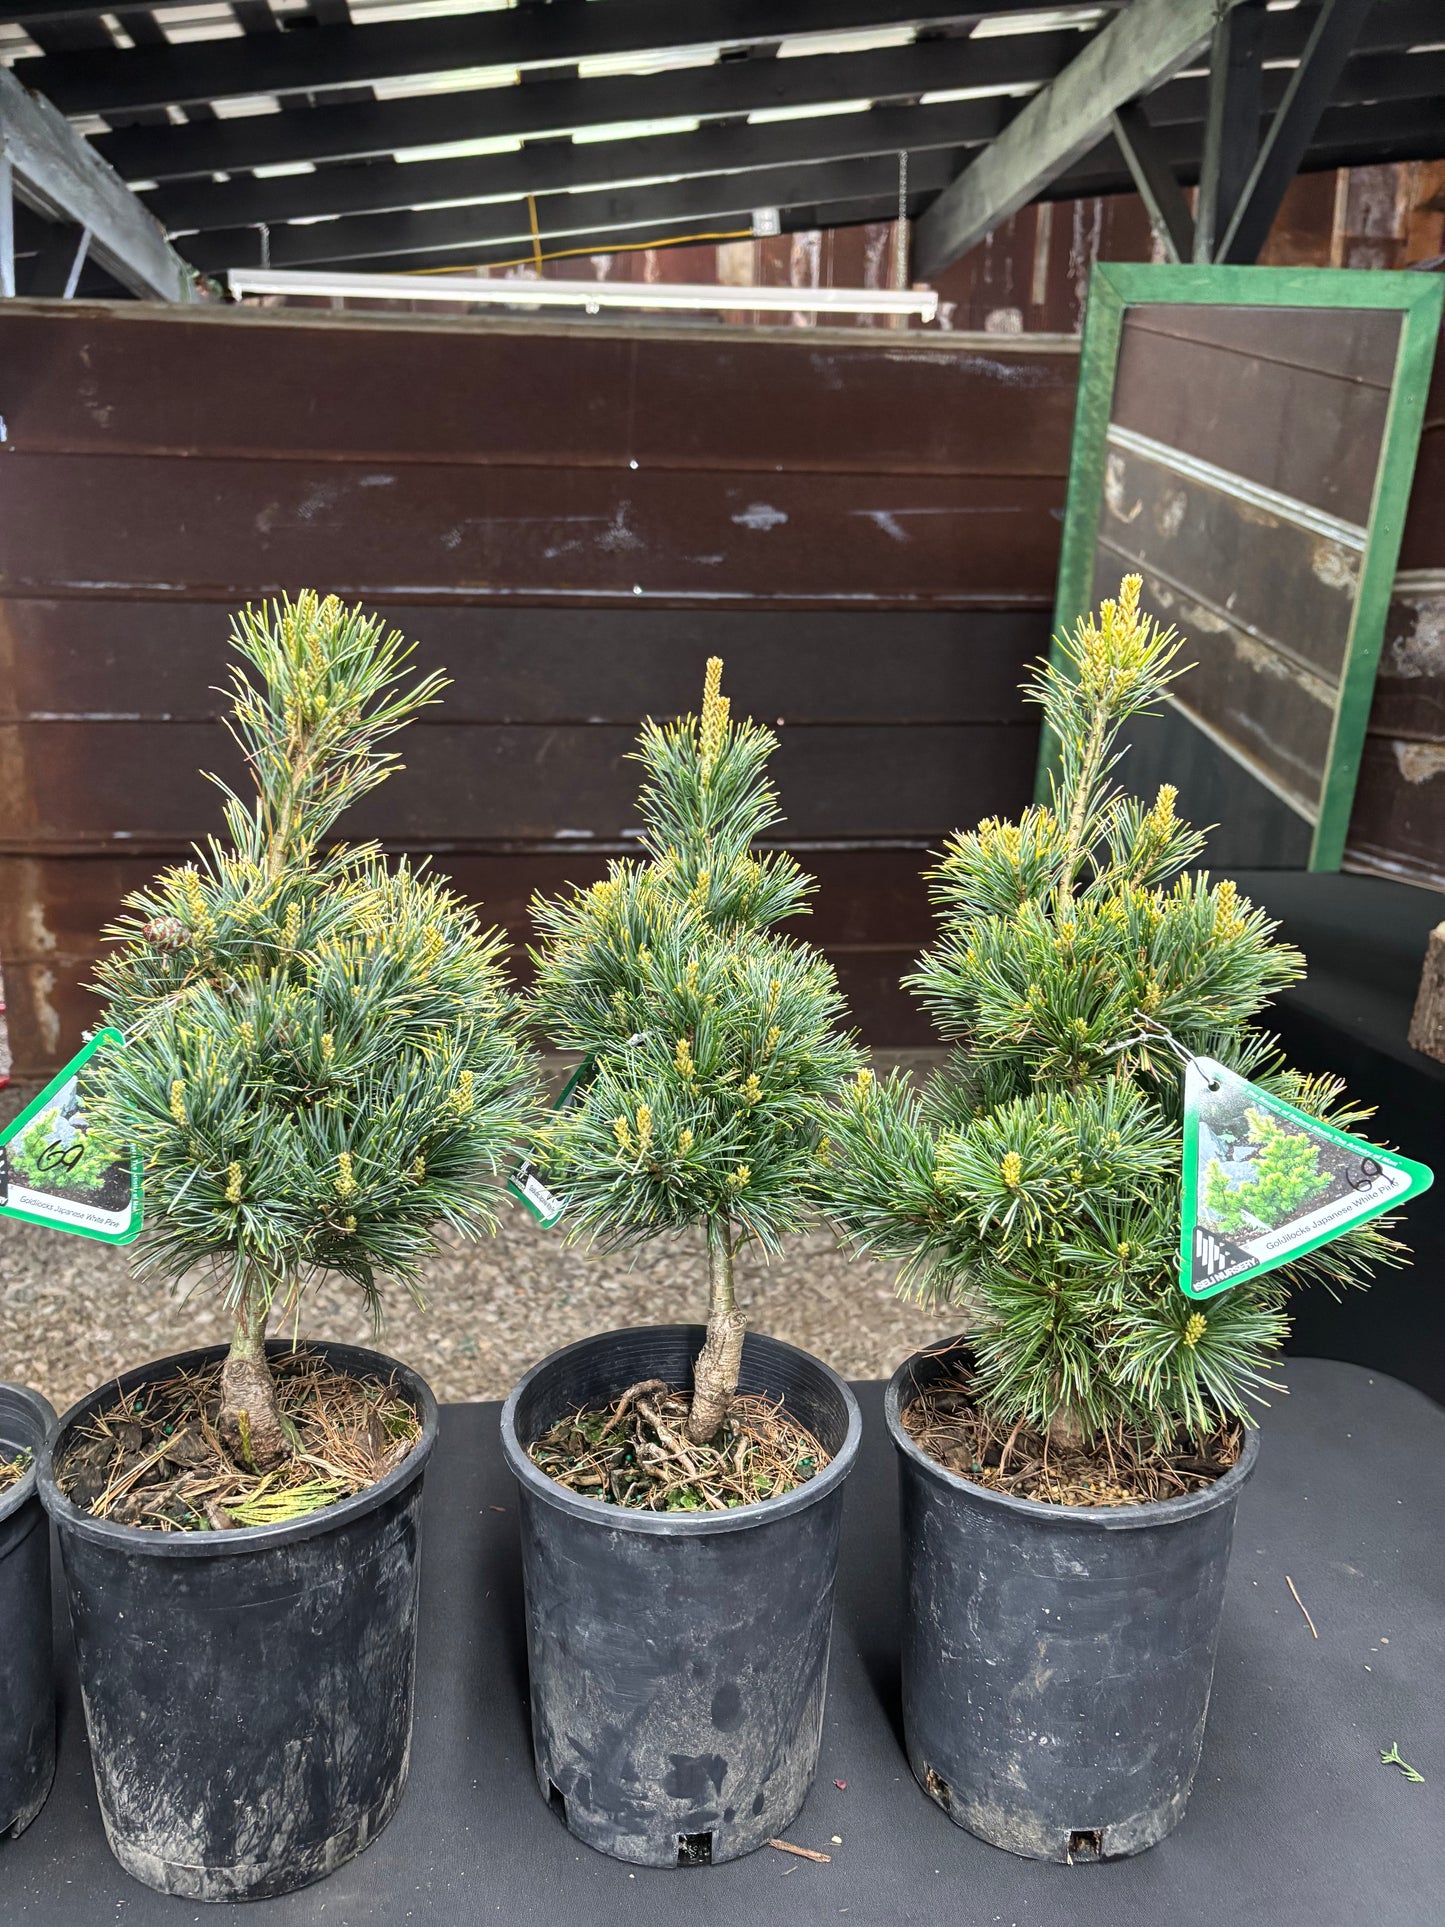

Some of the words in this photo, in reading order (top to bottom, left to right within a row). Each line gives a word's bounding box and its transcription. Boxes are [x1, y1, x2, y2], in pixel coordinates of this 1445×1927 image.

[1289, 1113, 1312, 1128] Nature
[1347, 1142, 1373, 1157] Artistry
[20, 1195, 54, 1211] Goldilocks
[53, 1205, 85, 1219] Japanese
[85, 1213, 104, 1224] White
[1266, 1226, 1311, 1251] Goldilocks
[1312, 1206, 1353, 1229] Japanese
[1351, 1192, 1379, 1208] White
[1193, 1276, 1217, 1291] ISELI
[1214, 1257, 1256, 1282] NURSERY
